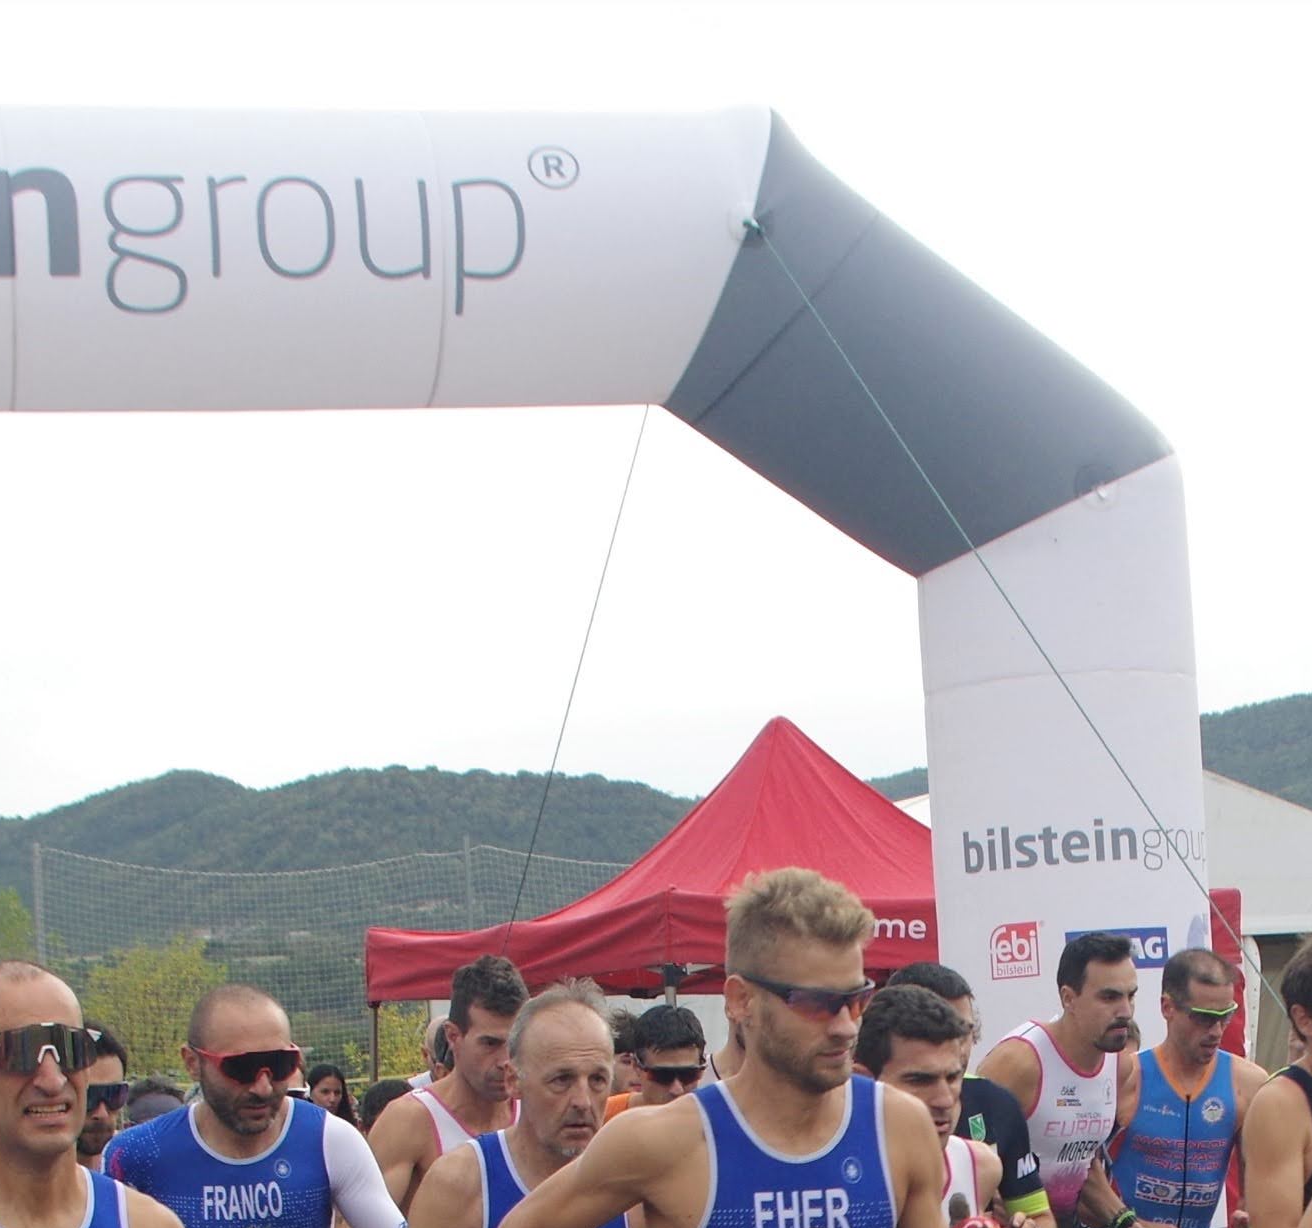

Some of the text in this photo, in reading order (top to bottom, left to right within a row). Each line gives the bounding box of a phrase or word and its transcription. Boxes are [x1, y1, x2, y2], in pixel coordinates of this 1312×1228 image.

[990, 922, 1039, 963] febi
[995, 962, 1034, 977] bilstein
[202, 1181, 284, 1220] FRANCO
